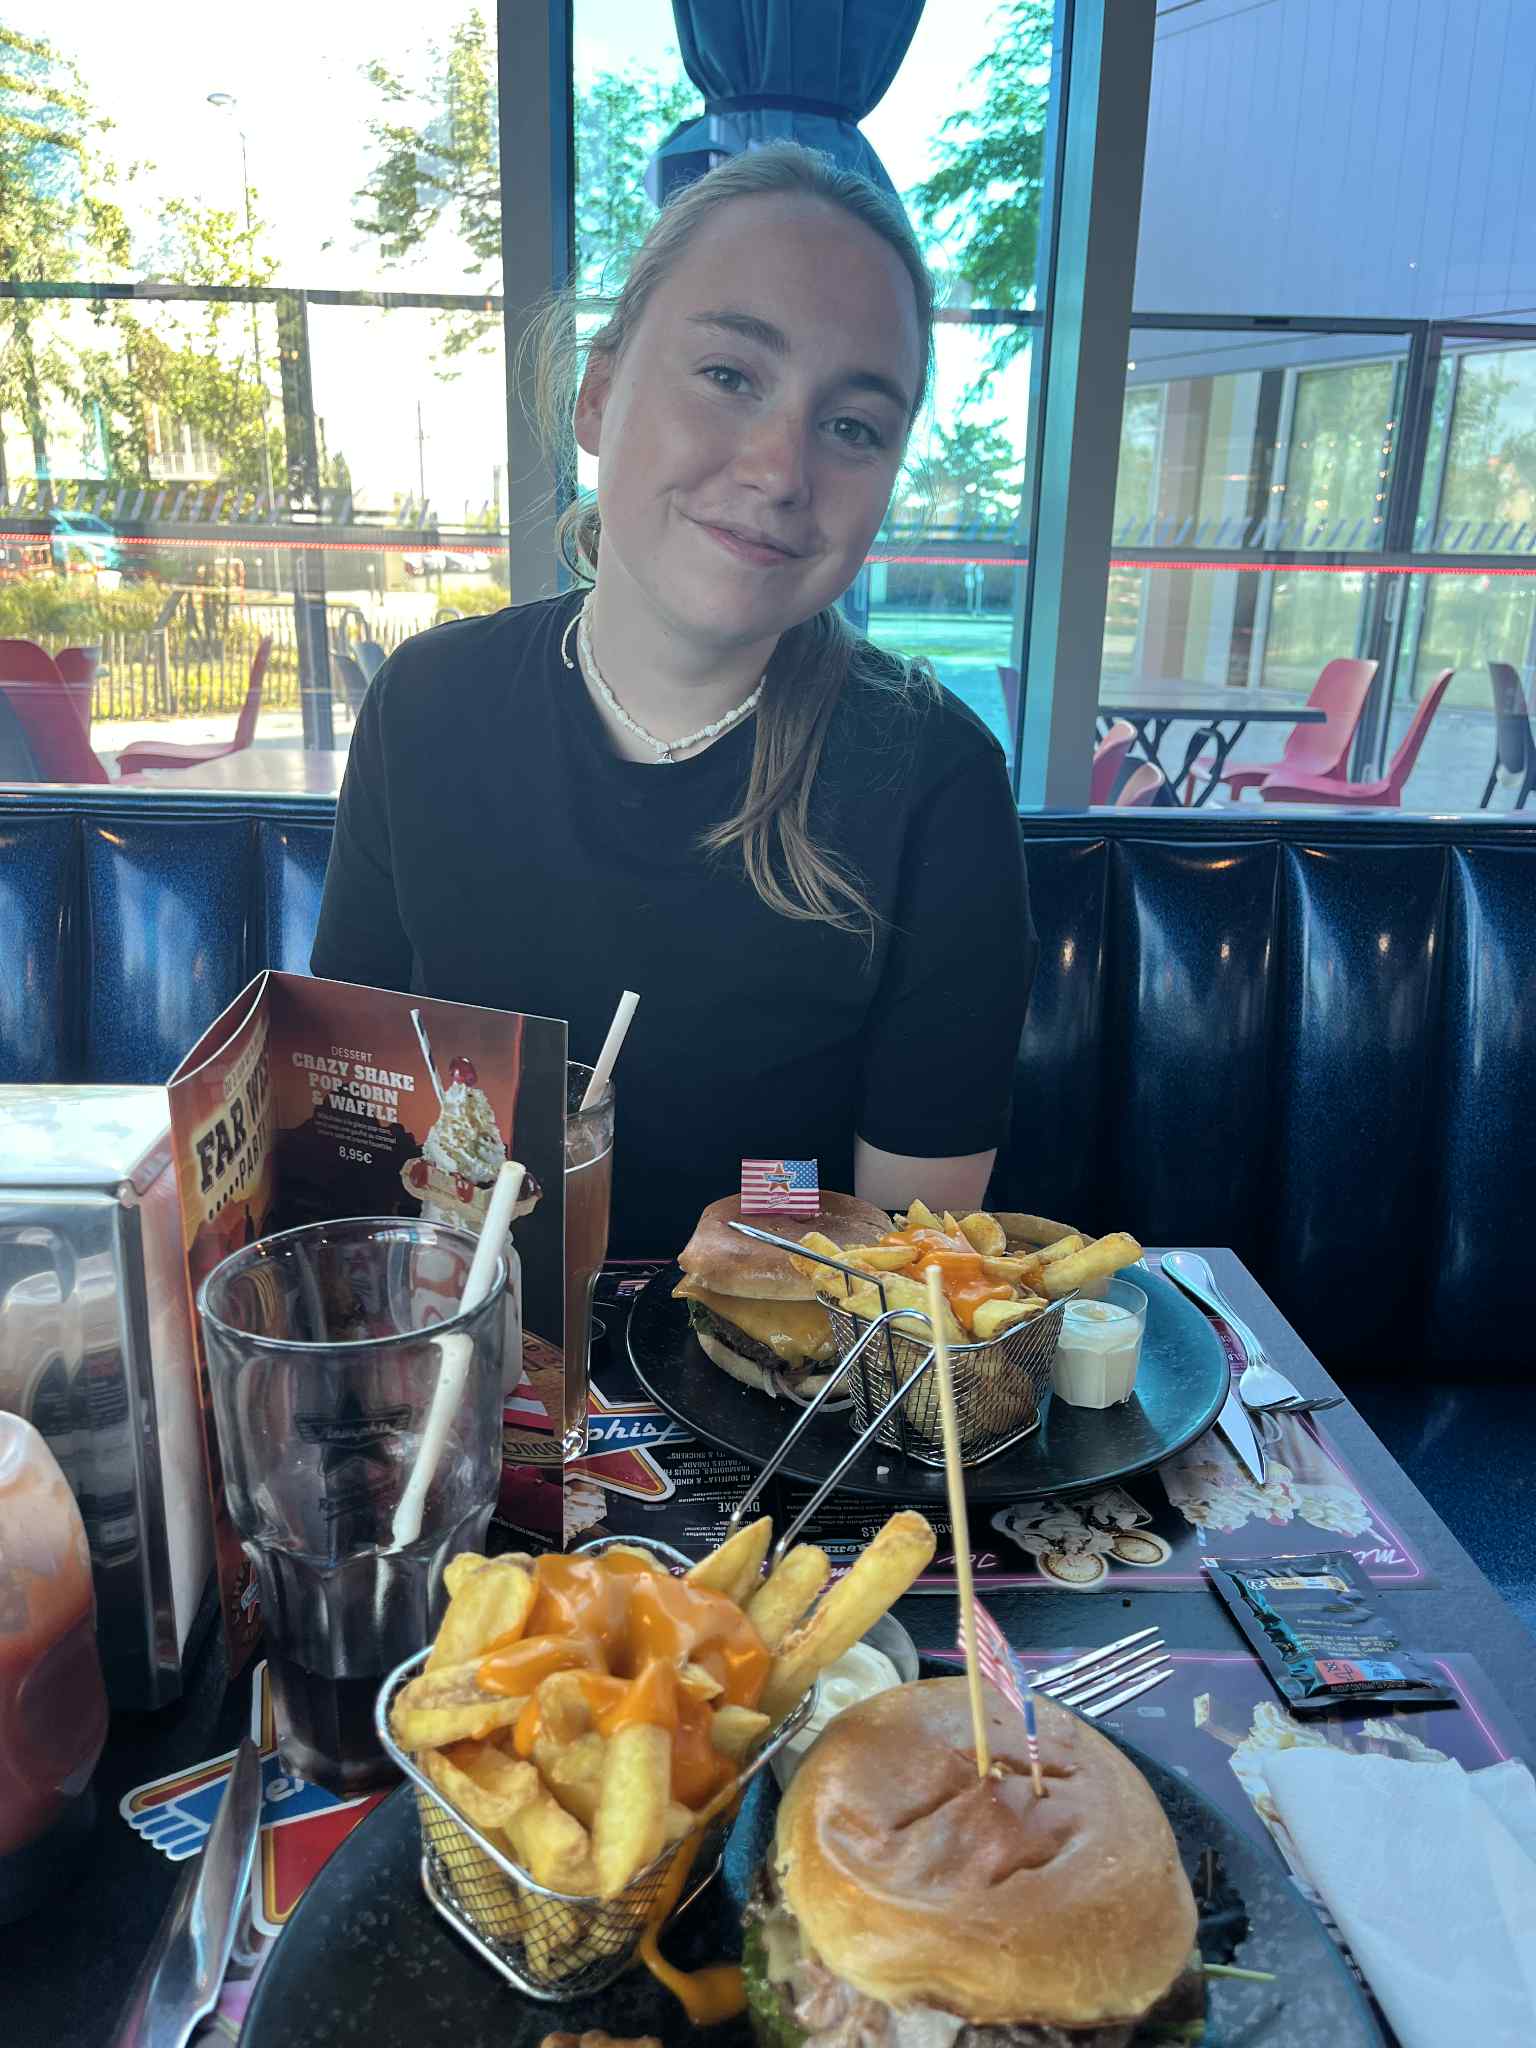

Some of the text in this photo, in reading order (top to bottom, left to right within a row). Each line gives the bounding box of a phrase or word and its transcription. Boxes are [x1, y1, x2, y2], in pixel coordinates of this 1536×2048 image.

[331, 1046, 373, 1063] DESSERT
[292, 1052, 415, 1092] CRAZY SHAKE
[308, 1071, 399, 1106] POP-CORN
[311, 1089, 399, 1124] & WAFFLE
[197, 1097, 247, 1194] FAR
[338, 1145, 373, 1165] 8,95€
[588, 1418, 658, 1442] phis
[669, 1477, 694, 1487] KINDE
[717, 1502, 760, 1513] DEUXE
